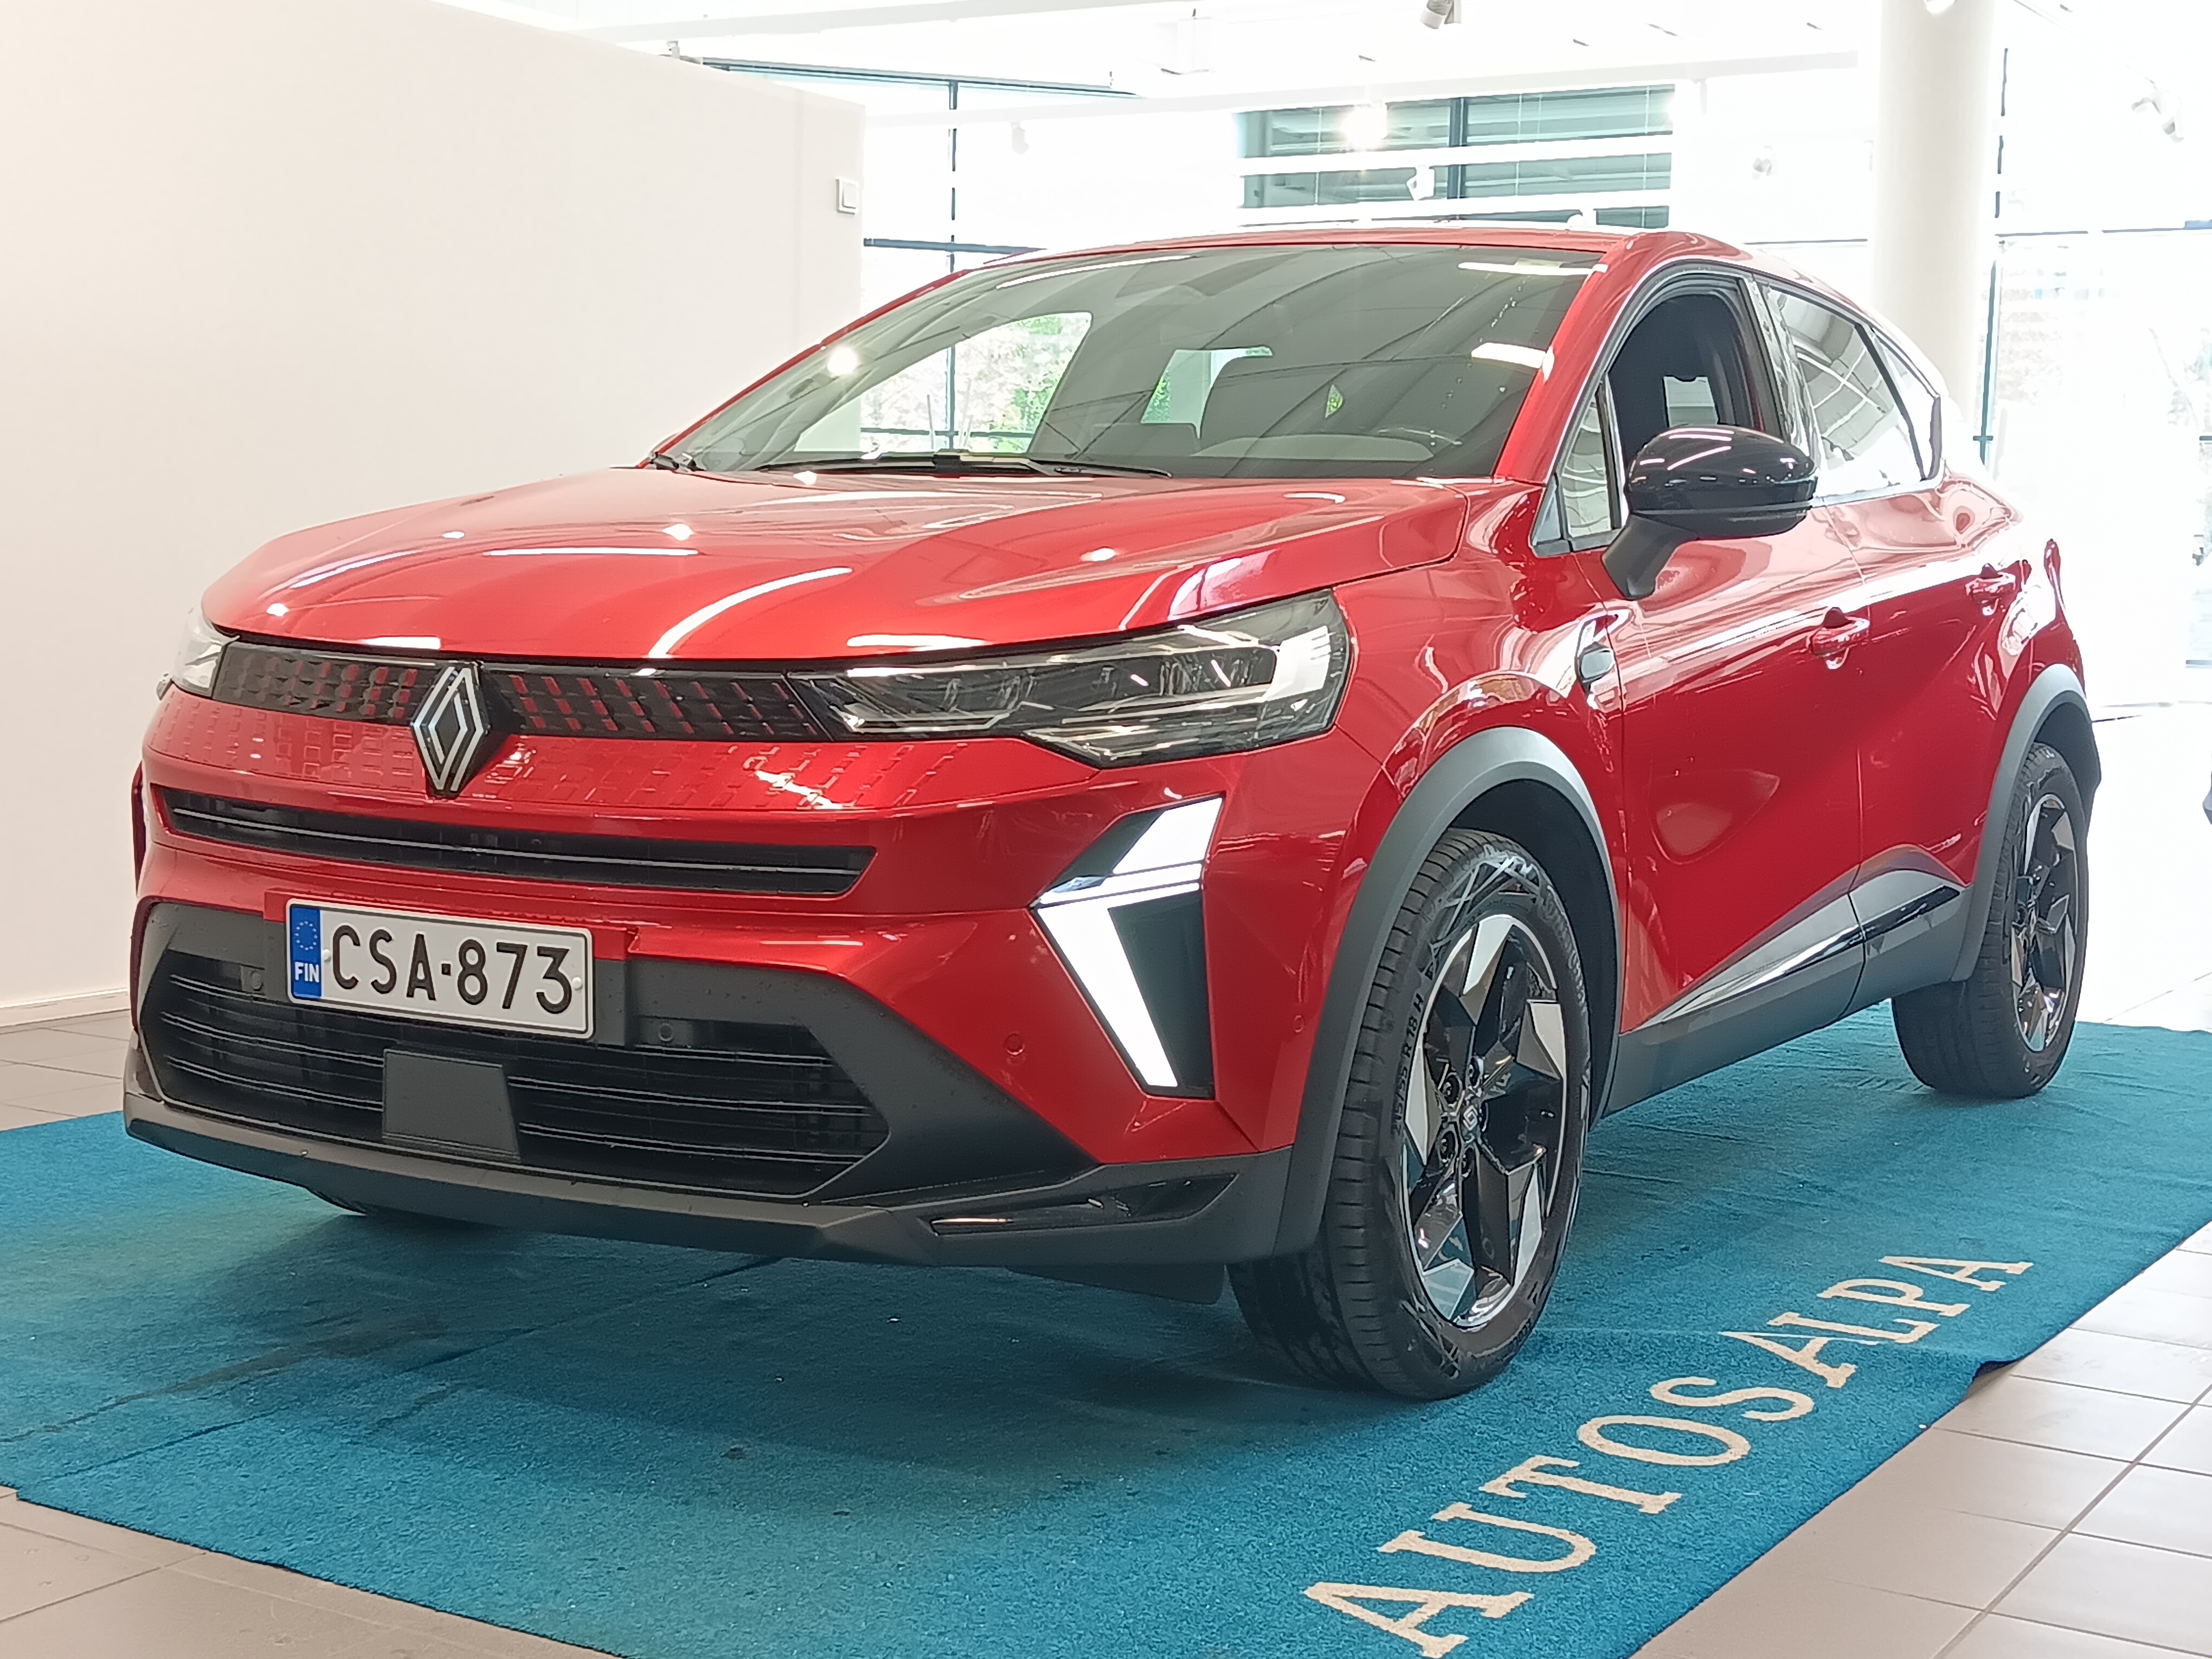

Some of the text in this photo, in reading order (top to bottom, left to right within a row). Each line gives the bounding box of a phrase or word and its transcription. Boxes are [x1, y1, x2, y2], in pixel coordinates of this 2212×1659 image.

[294, 962, 319, 983] FIN
[332, 924, 573, 1015] CSA-873
[1413, 993, 1424, 1013] H
[1406, 1015, 1418, 1038] 18
[1402, 1043, 1412, 1058] R
[1303, 1255, 2034, 1658] AUTOSALPA
